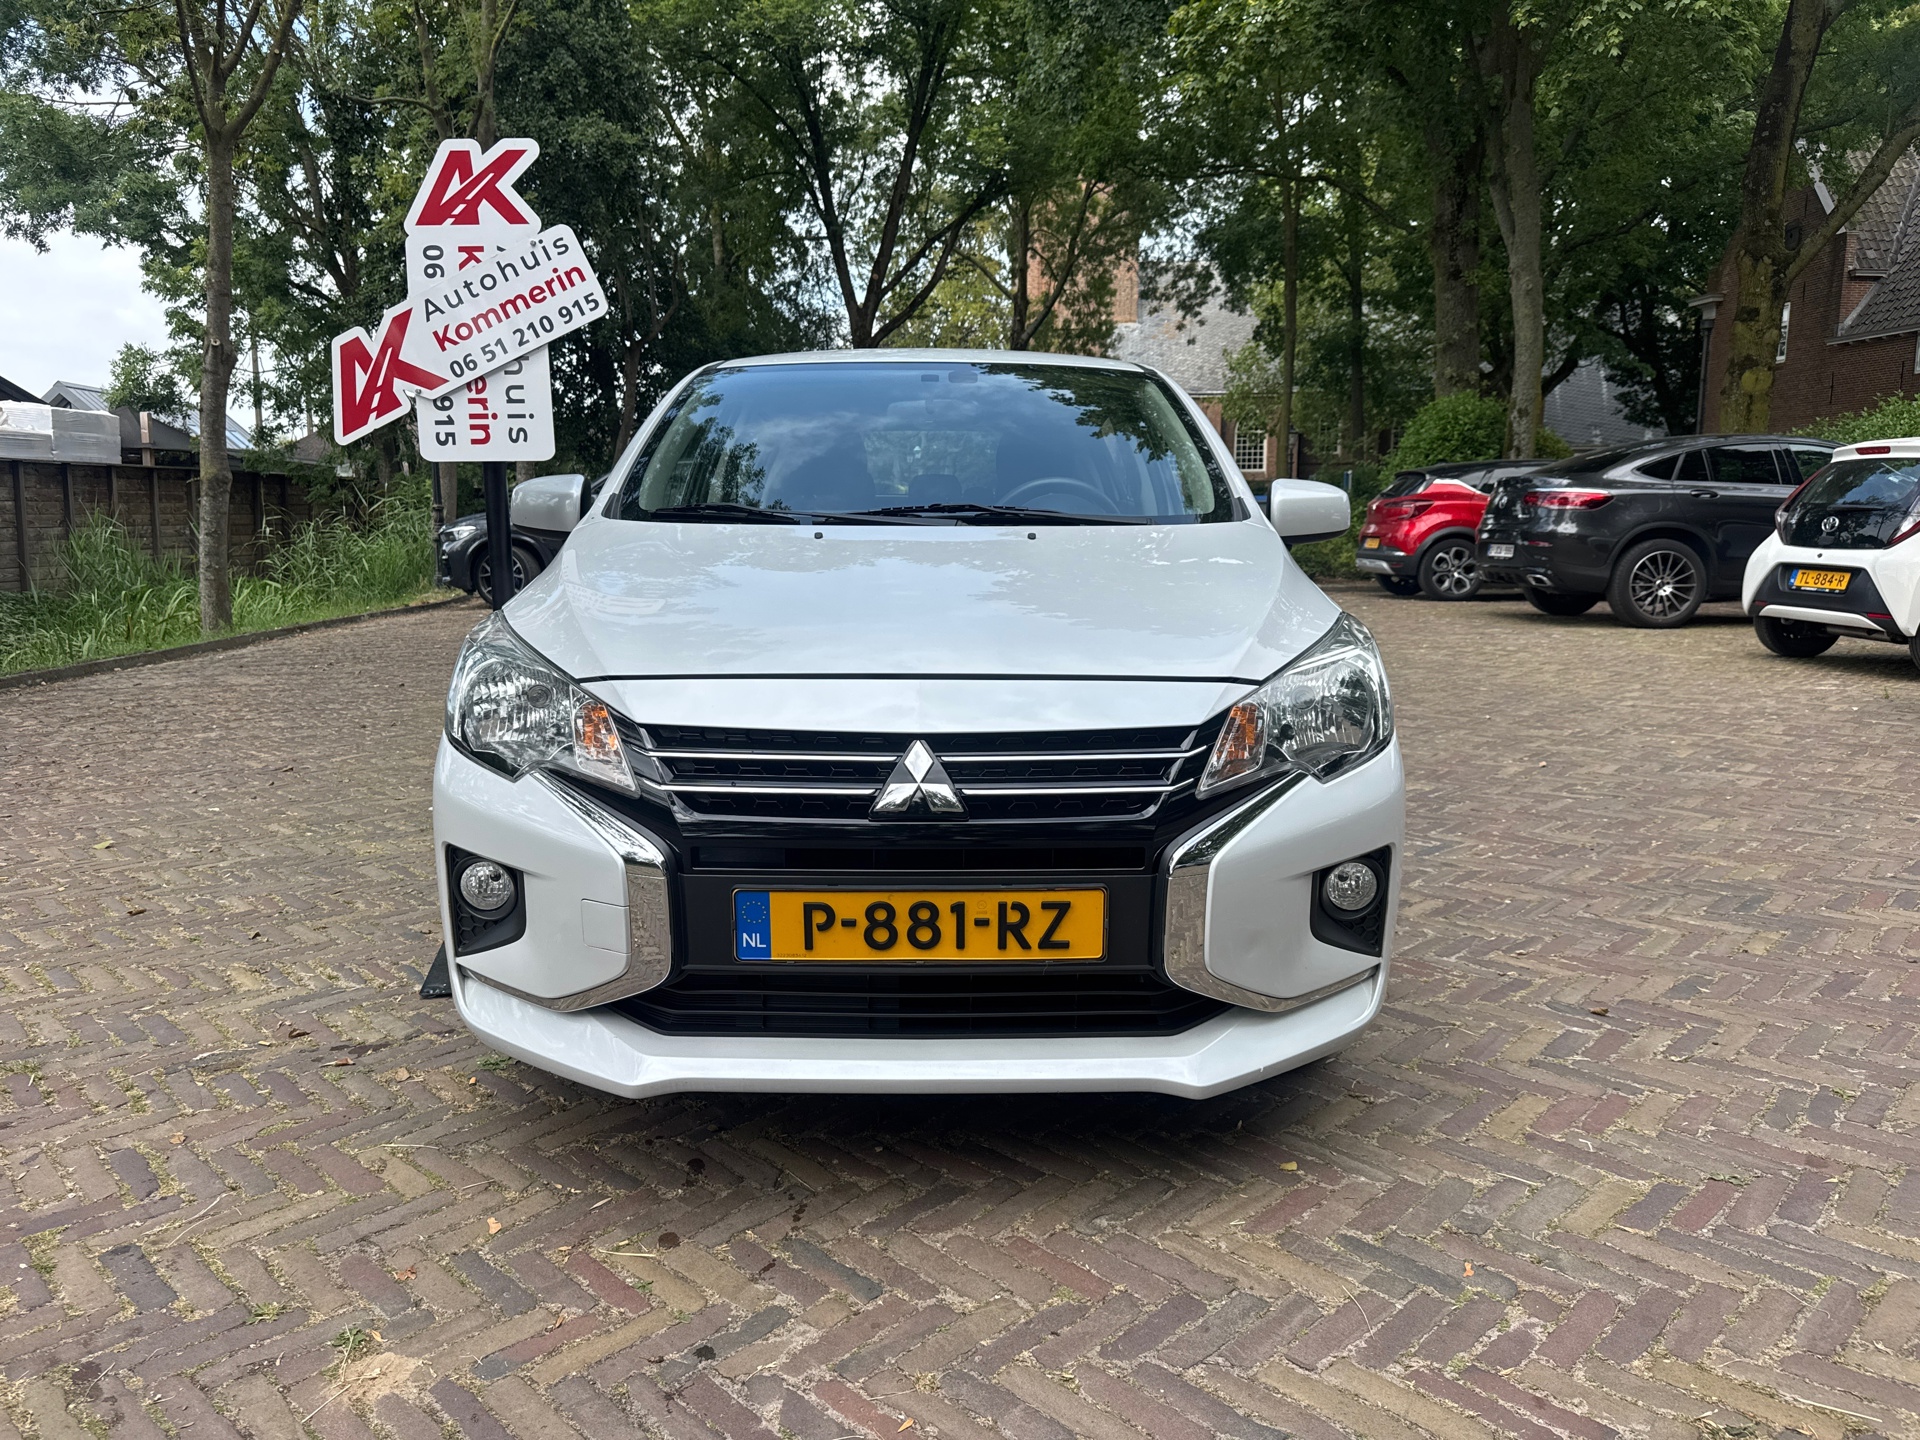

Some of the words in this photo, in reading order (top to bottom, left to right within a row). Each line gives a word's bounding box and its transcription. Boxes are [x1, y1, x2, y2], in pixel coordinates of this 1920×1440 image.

[423, 245, 444, 279] 06
[424, 236, 570, 322] Autohuis
[432, 266, 587, 352] Kommerin
[449, 353, 478, 378] 06
[480, 338, 508, 363] 51
[512, 315, 554, 348] 210
[558, 293, 600, 325] 915
[1799, 572, 1845, 587] TL-884-R
[742, 933, 766, 948] NL
[803, 901, 1071, 951] P-881-RZ
